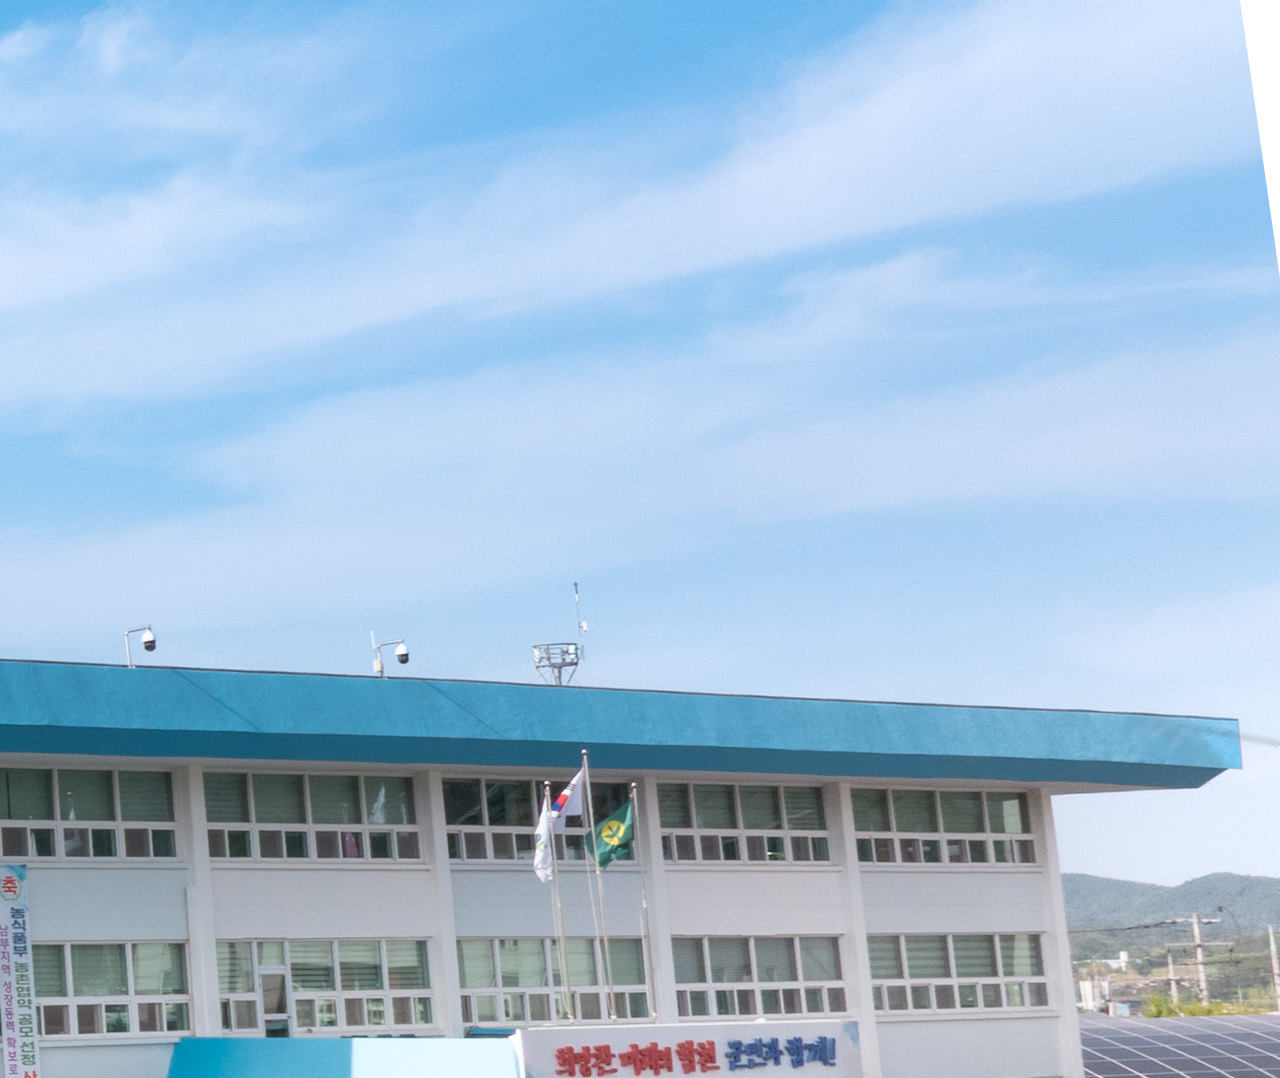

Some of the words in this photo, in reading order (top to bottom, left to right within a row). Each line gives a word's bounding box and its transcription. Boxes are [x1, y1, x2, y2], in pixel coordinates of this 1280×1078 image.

[2, 876, 18, 895] 축
[0, 925, 11, 977] 남부지역
[10, 907, 28, 957] 농식품부
[14, 962, 31, 1009] 농촌협약
[3, 980, 16, 1033] 성장동력
[18, 1014, 34, 1038] 공모
[6, 1037, 19, 1076] 확보로
[20, 1041, 36, 1066] 선정
[555, 1044, 618, 1077] 희망찬
[618, 1041, 673, 1076] 미래의
[675, 1040, 721, 1074] 합천
